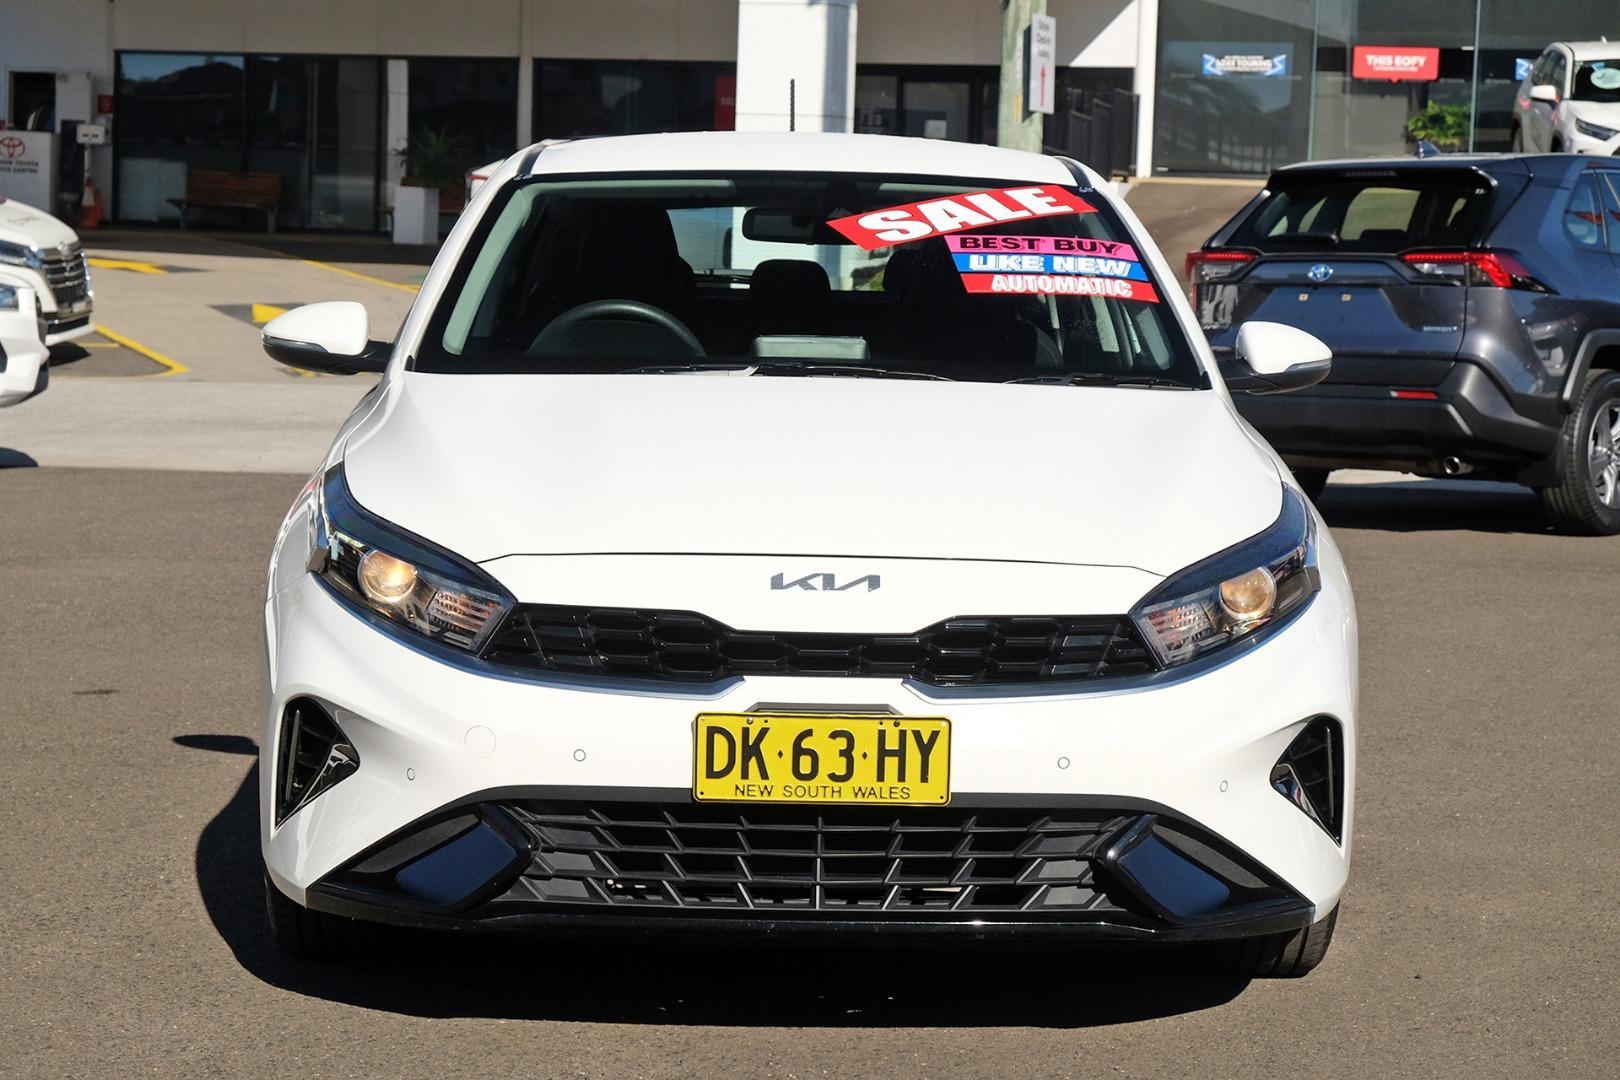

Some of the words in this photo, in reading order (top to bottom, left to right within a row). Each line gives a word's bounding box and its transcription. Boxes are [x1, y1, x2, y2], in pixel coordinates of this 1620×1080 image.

[1365, 54, 1393, 66] THIS
[1394, 55, 1427, 68] EOFY
[857, 187, 1075, 242] SALE
[960, 237, 1040, 251] BEST
[1054, 239, 1123, 254] BUY
[969, 254, 1045, 272] LIKE
[1052, 256, 1132, 277] NEW
[991, 275, 1134, 298] AUTOMATIC
[771, 572, 881, 592] KIA
[735, 784, 774, 797] NEW
[783, 785, 842, 799] SOUTH
[853, 786, 911, 800] WALES
